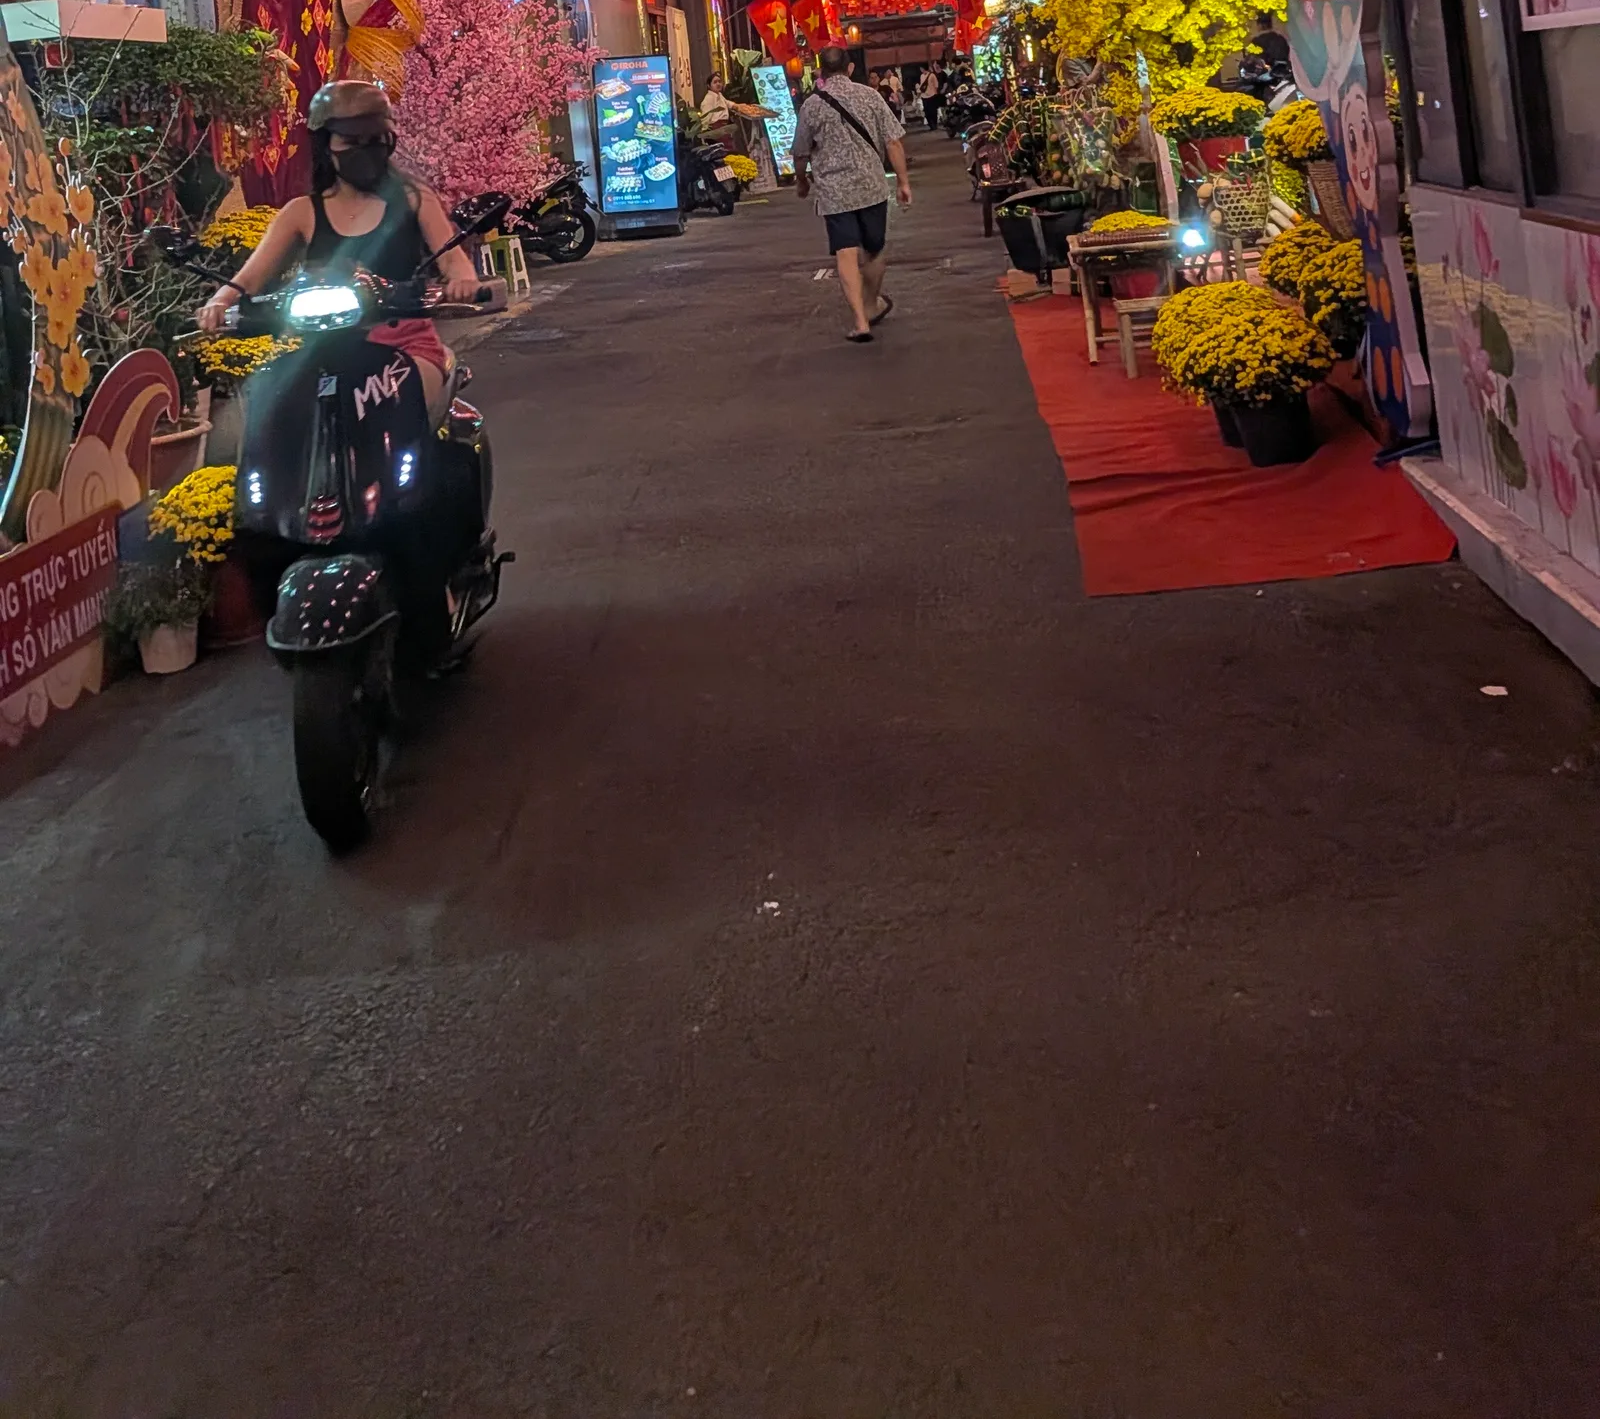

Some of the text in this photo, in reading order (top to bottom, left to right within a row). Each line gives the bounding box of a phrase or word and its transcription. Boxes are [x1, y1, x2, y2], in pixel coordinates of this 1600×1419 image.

[620, 60, 648, 70] IROHA
[20, 554, 67, 606] TRỰC
[68, 517, 119, 581] TUYẾN
[37, 610, 73, 659] VĂN
